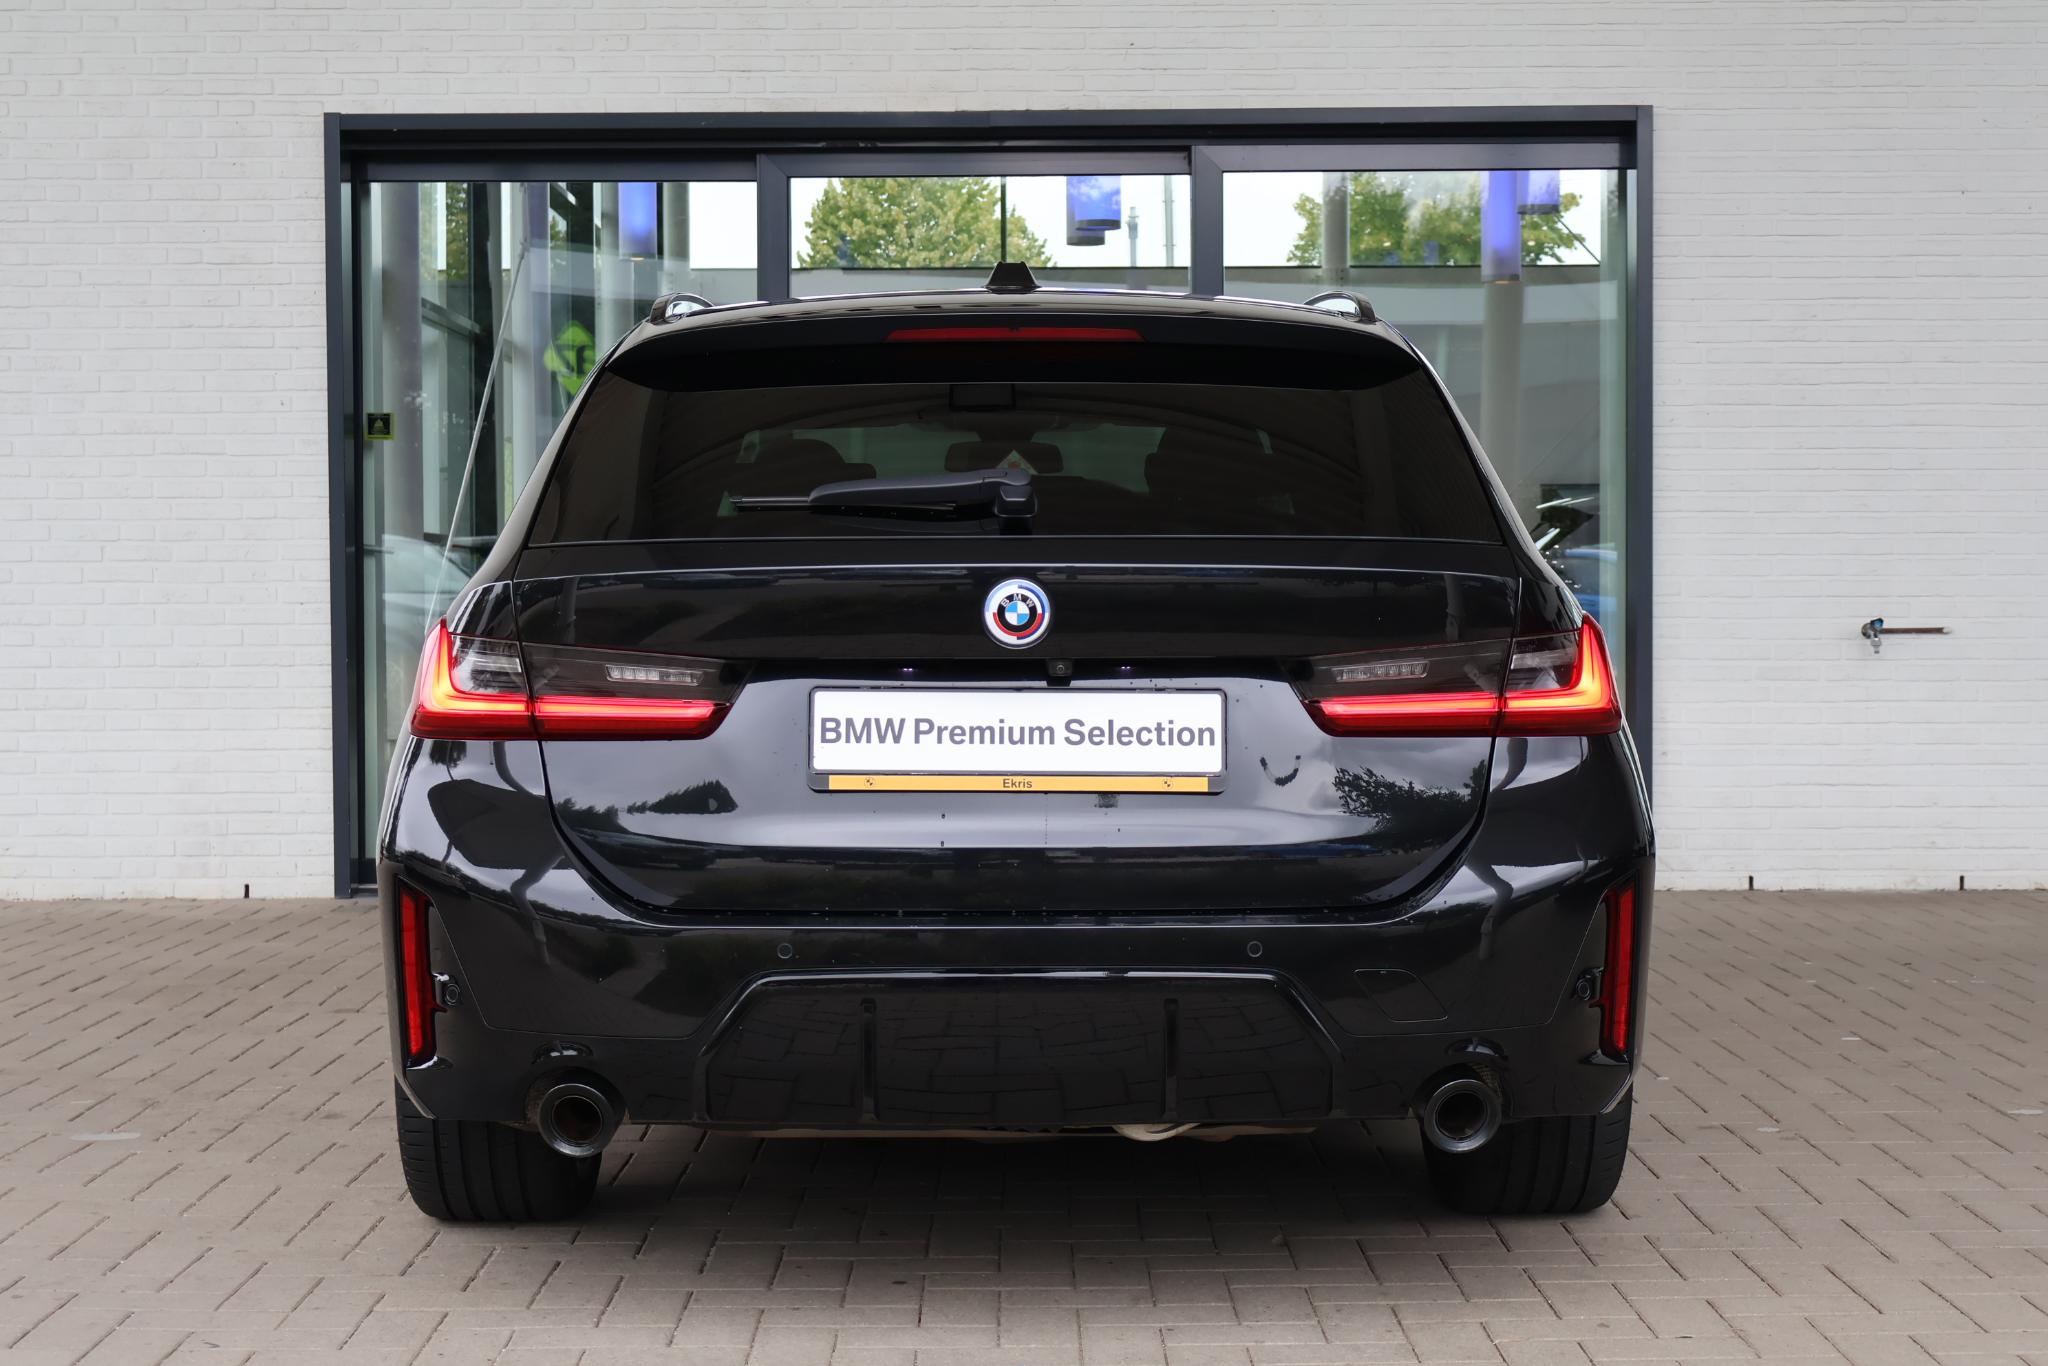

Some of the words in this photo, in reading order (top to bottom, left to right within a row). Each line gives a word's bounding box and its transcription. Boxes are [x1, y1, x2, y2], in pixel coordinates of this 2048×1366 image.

[1000, 593, 1035, 608] BMW
[820, 717, 906, 744] BMW
[914, 718, 1055, 746] Premium
[1064, 718, 1216, 747] Selection
[1002, 778, 1033, 789] Ekris
